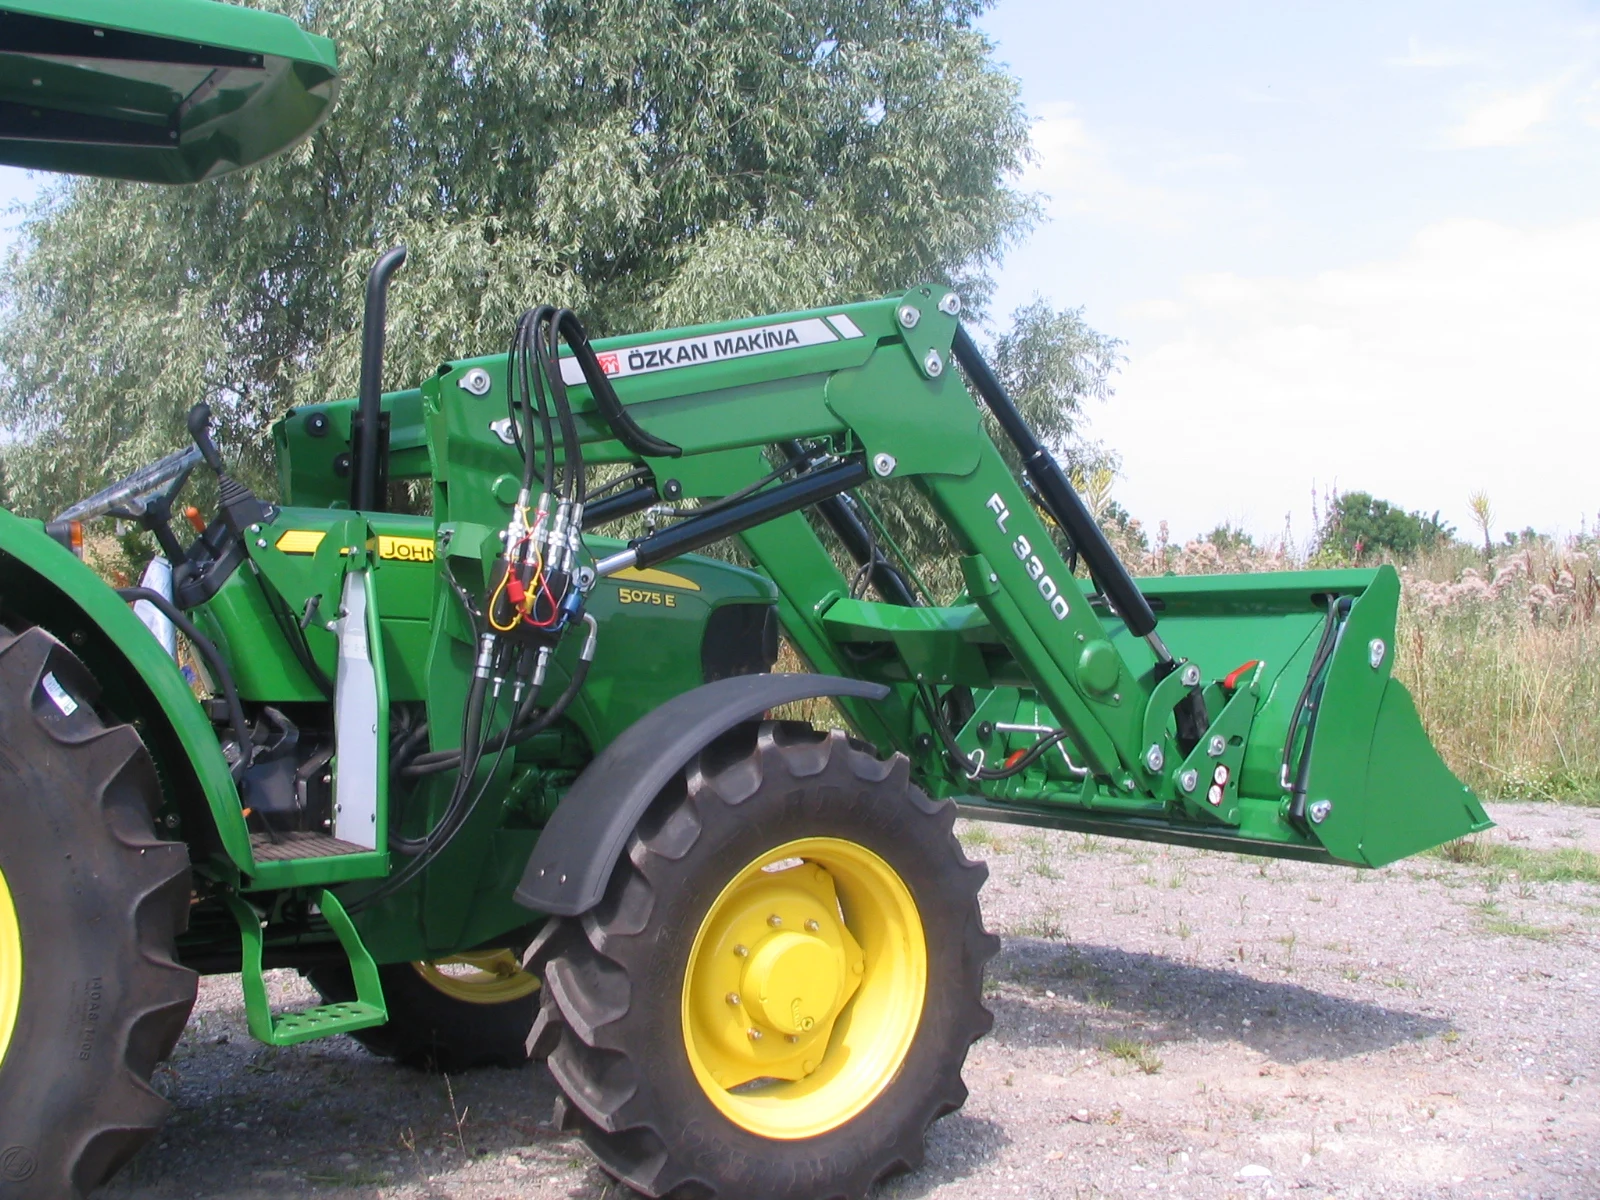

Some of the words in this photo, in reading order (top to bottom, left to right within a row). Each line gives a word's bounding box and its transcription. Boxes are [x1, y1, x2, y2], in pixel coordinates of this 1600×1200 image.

[627, 342, 708, 371] ÖZKAN
[714, 328, 799, 357] MAKİNA
[985, 492, 1010, 534] FL
[1012, 535, 1069, 620] 3300
[619, 588, 661, 605] 5075
[665, 594, 676, 607] E
